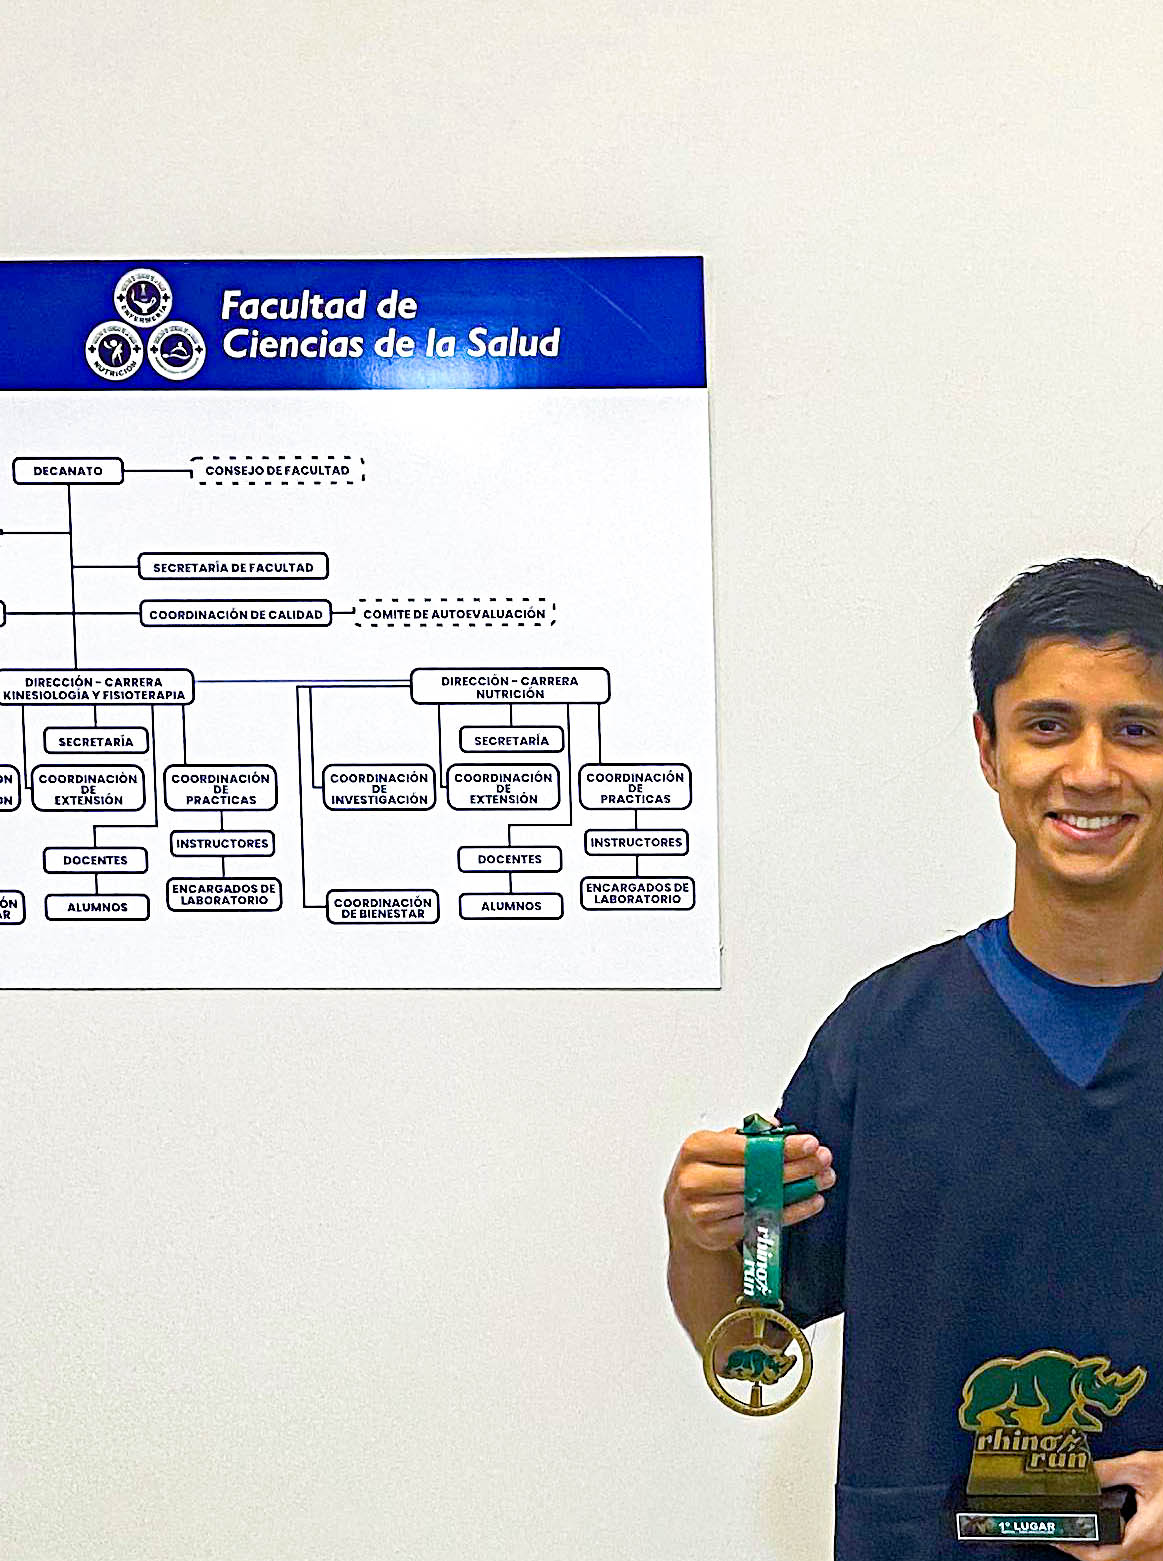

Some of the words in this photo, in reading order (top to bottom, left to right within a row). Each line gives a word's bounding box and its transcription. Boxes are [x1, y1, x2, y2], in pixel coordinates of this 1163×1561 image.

[222, 290, 366, 319] Facultad
[377, 290, 417, 318] de
[224, 329, 363, 358] Ciencias
[374, 328, 416, 358] de
[426, 328, 456, 358] la
[467, 327, 561, 358] Salud
[34, 467, 102, 475] DECANATO
[206, 466, 264, 475] CONSEJO
[267, 466, 282, 475] DE
[285, 466, 349, 475] FACULTAD
[154, 561, 228, 572] SECRETARÍA
[232, 563, 246, 572] DE
[250, 563, 313, 572] FACULTAD
[150, 608, 248, 619] COORDINACIÓN
[250, 610, 266, 619] DE
[269, 610, 322, 619] CALIDAD
[364, 610, 410, 619] COMITE
[414, 610, 428, 619] DE
[432, 607, 545, 619] AUTOEVALUACIÓN
[26, 675, 90, 687] DIRECCIÓN
[105, 678, 162, 687] CARRERA
[442, 674, 508, 686] DIRECCIÓN
[521, 677, 578, 688] CARRERA
[4, 689, 89, 700] KINESIOLOGÍA
[92, 691, 100, 699] Y
[103, 691, 185, 699] FISIOTERAPIA
[477, 687, 544, 698] NUTRICIÓN
[59, 735, 133, 746] SECRETARÍA
[475, 734, 549, 745] SECRETARÍA
[39, 772, 137, 783] COORDINACIÓN
[172, 772, 269, 783] COORDINACIÓN
[331, 771, 427, 783] COORDINACIÓN
[455, 772, 552, 782] COORDINACIÓN
[587, 771, 683, 782] COORDINACIÓN
[81, 786, 96, 794] DE
[214, 785, 228, 794] DE
[372, 785, 387, 793] DE
[497, 784, 510, 793] DE
[629, 784, 642, 792] DE
[55, 794, 122, 805] EXTENSIÓN
[187, 796, 256, 804] PRACTICAS
[332, 794, 427, 804] INVESTIGACIÓN
[470, 793, 537, 804] EXTENSIÓN
[601, 795, 670, 803] PRACTICAS
[177, 839, 268, 848] INSTRUCTORES
[591, 838, 682, 847] INSTRUCTORES
[64, 856, 127, 865] DOCENTES
[479, 855, 541, 864] DOCENTES
[173, 884, 257, 893] ENCARGADOS
[261, 884, 275, 893] DE
[587, 883, 671, 892] ENCARGADOS
[675, 883, 688, 892] DE
[181, 896, 268, 905] LABORATORIO
[334, 897, 431, 907] COORDINACIÓN
[595, 895, 681, 903] LABORATORIO
[68, 903, 127, 912] ALUMNOS
[482, 902, 541, 911] ALUMNOS
[342, 909, 356, 918] DE
[360, 909, 424, 918] BIENESTAR
[976, 1428, 1063, 1451] rhino
[1030, 1451, 1088, 1468] run
[1013, 1521, 1056, 1531] LUGAR
